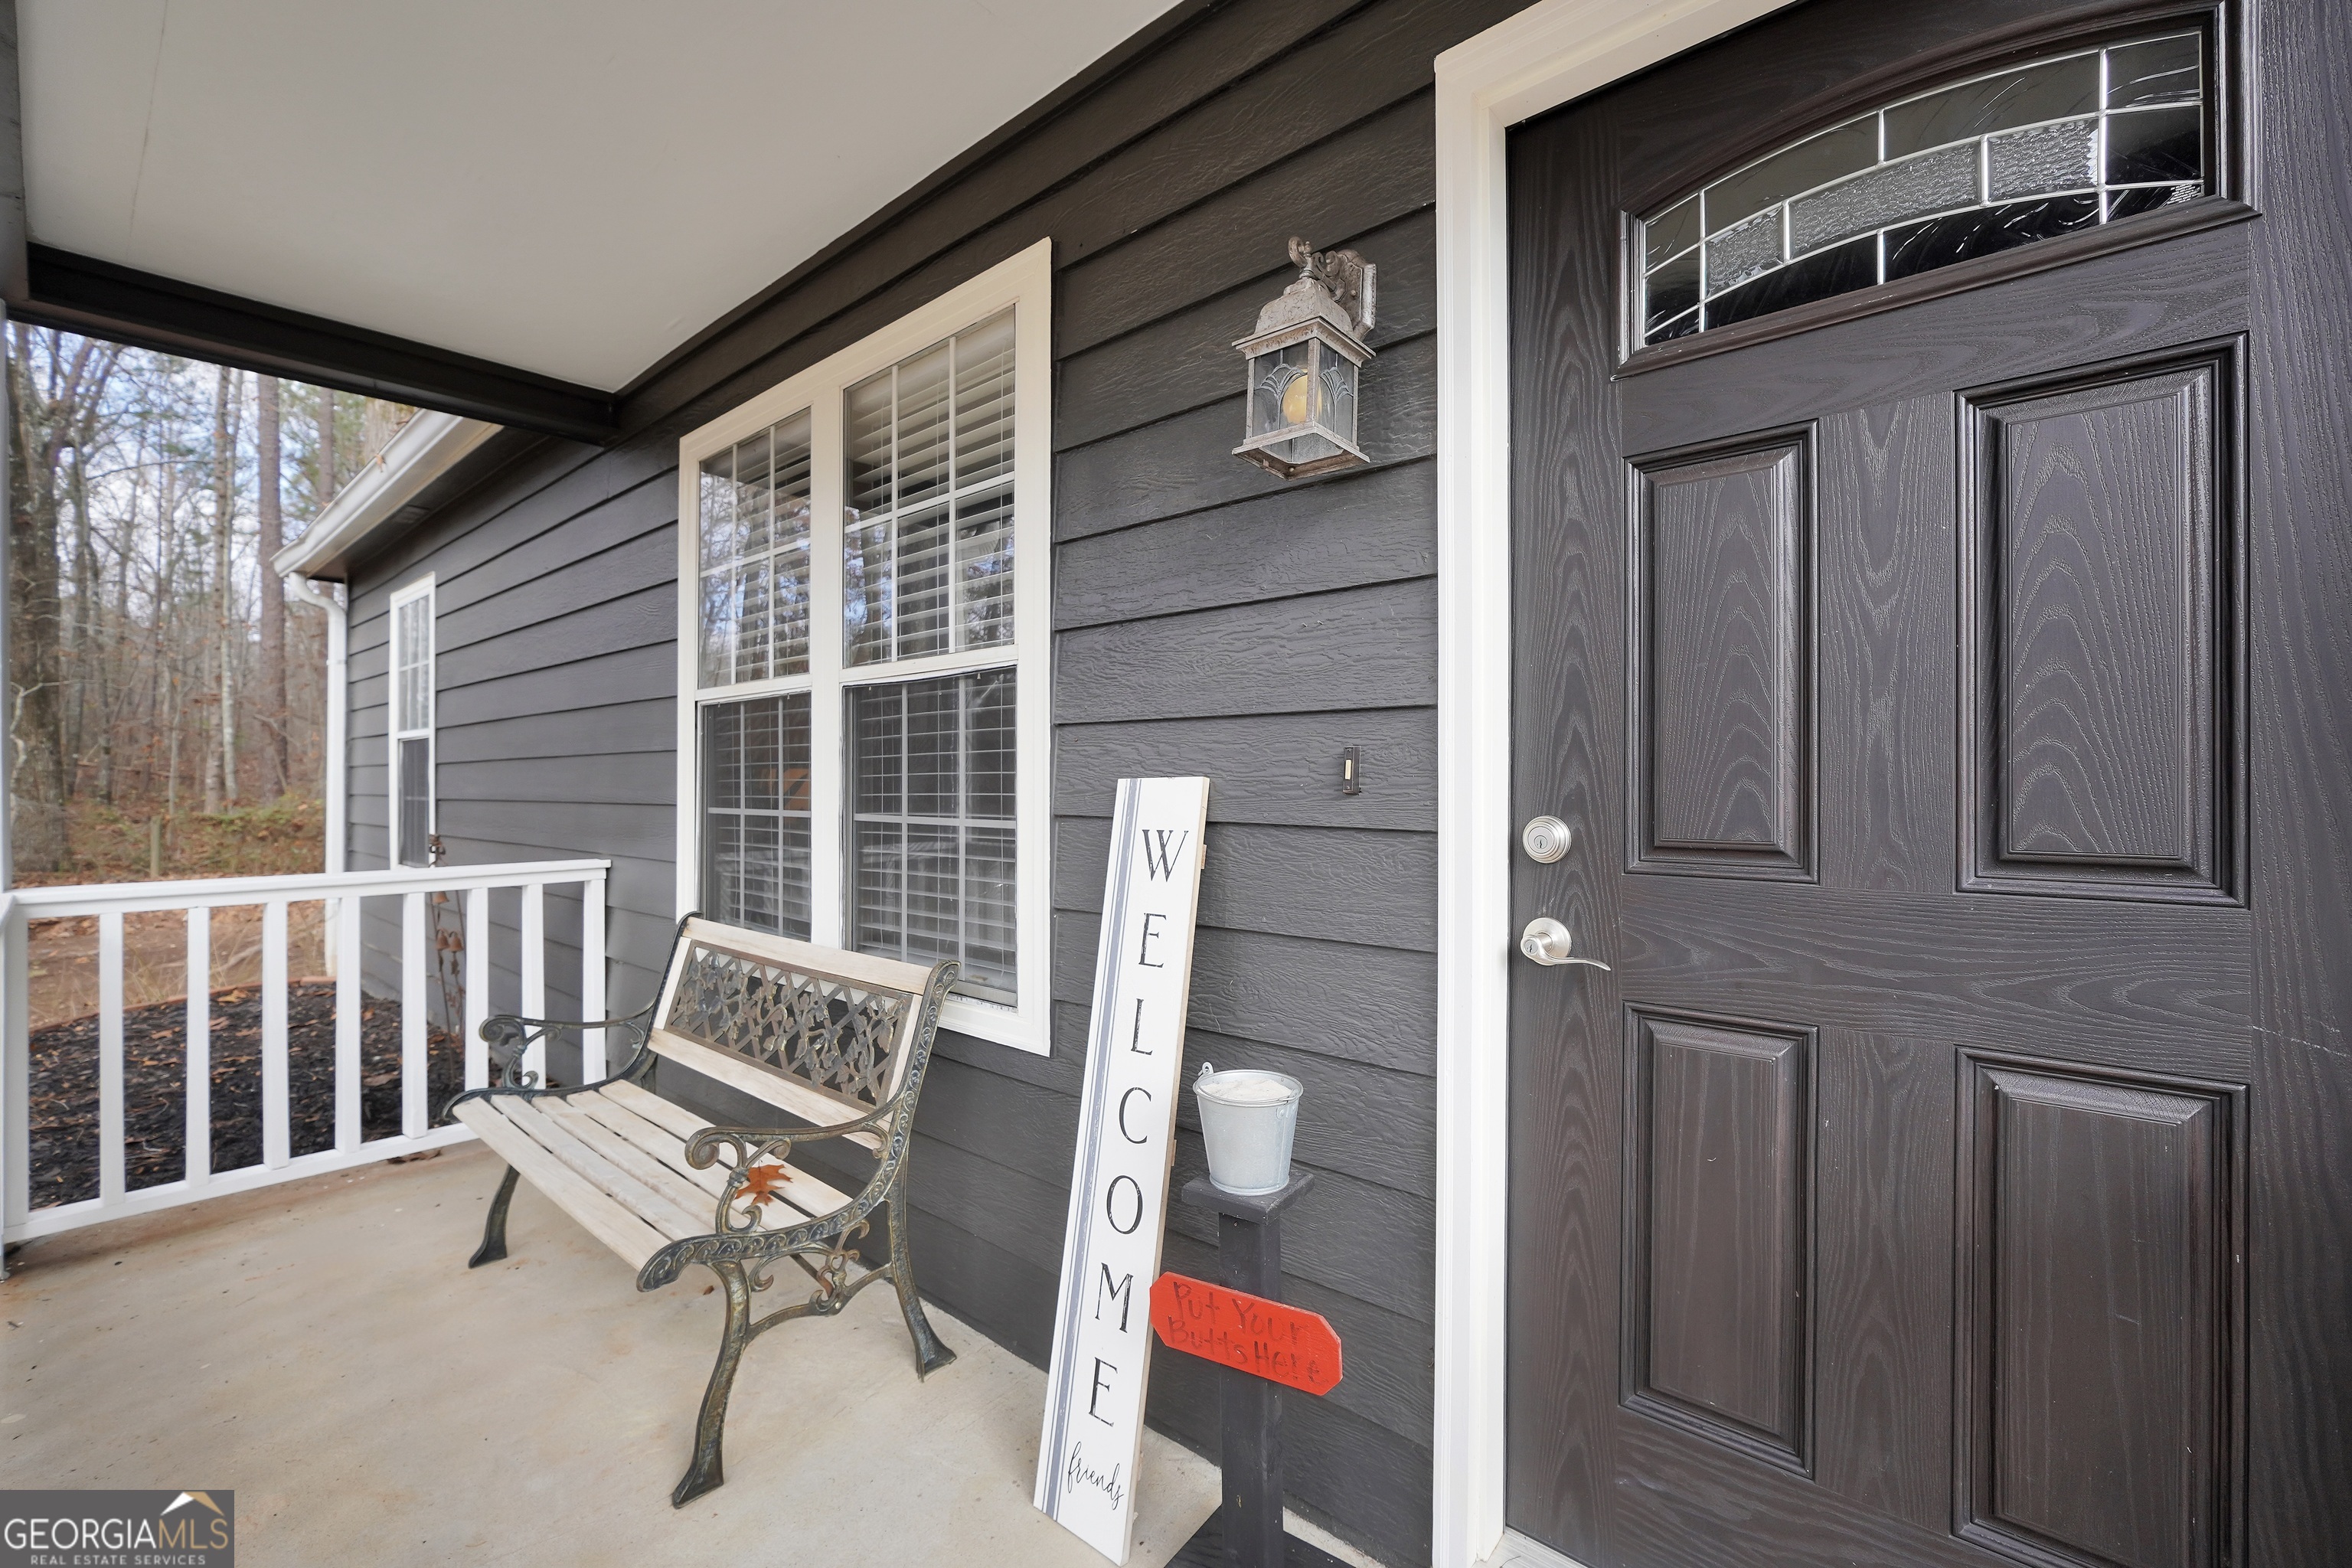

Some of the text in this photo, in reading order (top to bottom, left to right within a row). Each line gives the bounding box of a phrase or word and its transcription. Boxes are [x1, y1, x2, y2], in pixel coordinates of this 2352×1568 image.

[1088, 828, 1189, 1427] WELCOME
[1173, 1281, 1310, 1345] Put Your
[1168, 1315, 1328, 1386] Butts Here
[1067, 1441, 1125, 1511] friends
